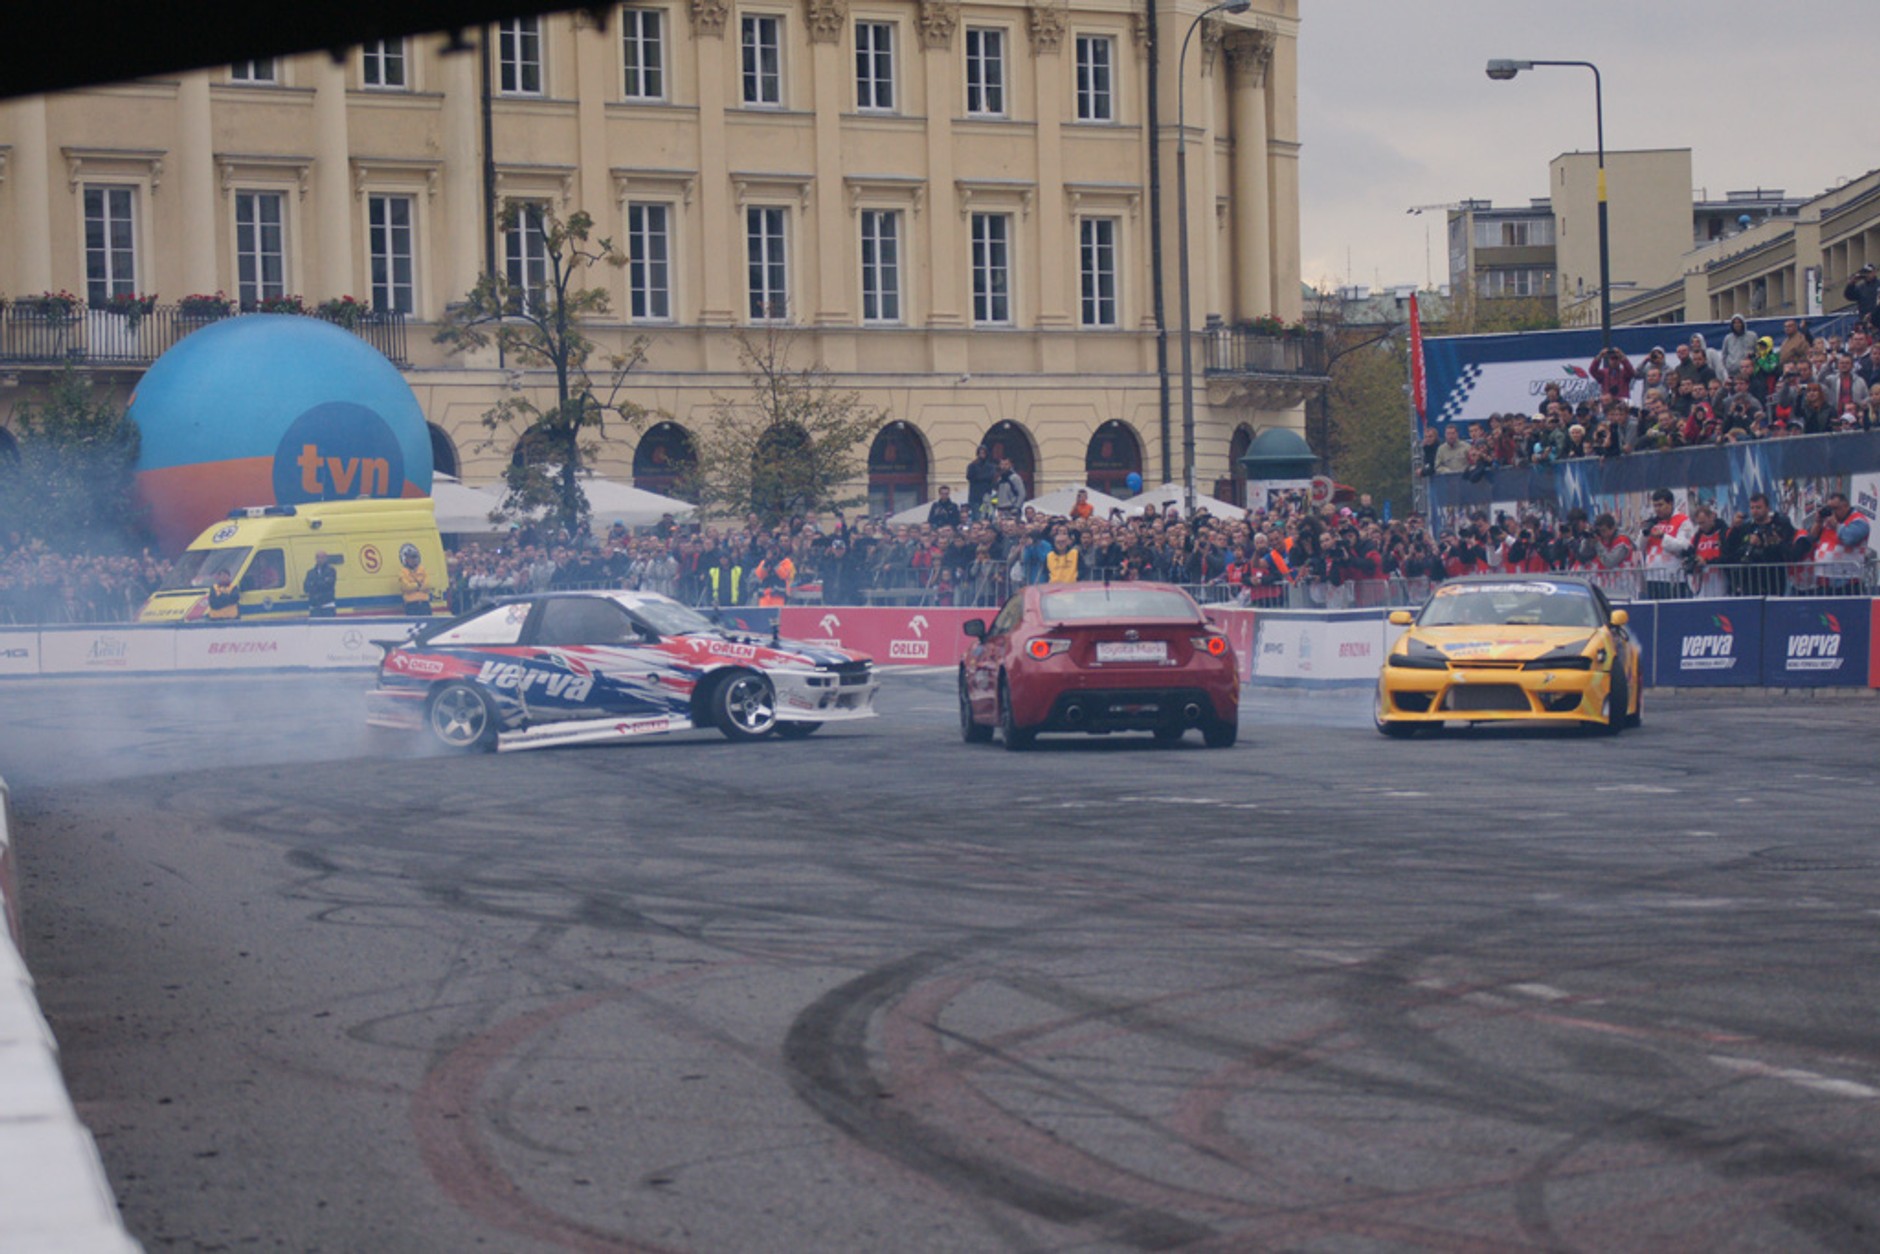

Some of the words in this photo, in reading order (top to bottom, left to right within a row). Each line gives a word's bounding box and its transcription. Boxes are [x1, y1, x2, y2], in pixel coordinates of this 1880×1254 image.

[297, 444, 389, 496] tvn
[364, 549, 379, 569] S
[208, 641, 277, 654] BENZINA
[711, 643, 753, 657] ORLEN
[891, 643, 926, 655] ORLEN
[1682, 634, 1733, 656] verva
[1788, 634, 1840, 656] verva
[411, 660, 442, 672] ORLEN
[475, 660, 594, 702] verva
